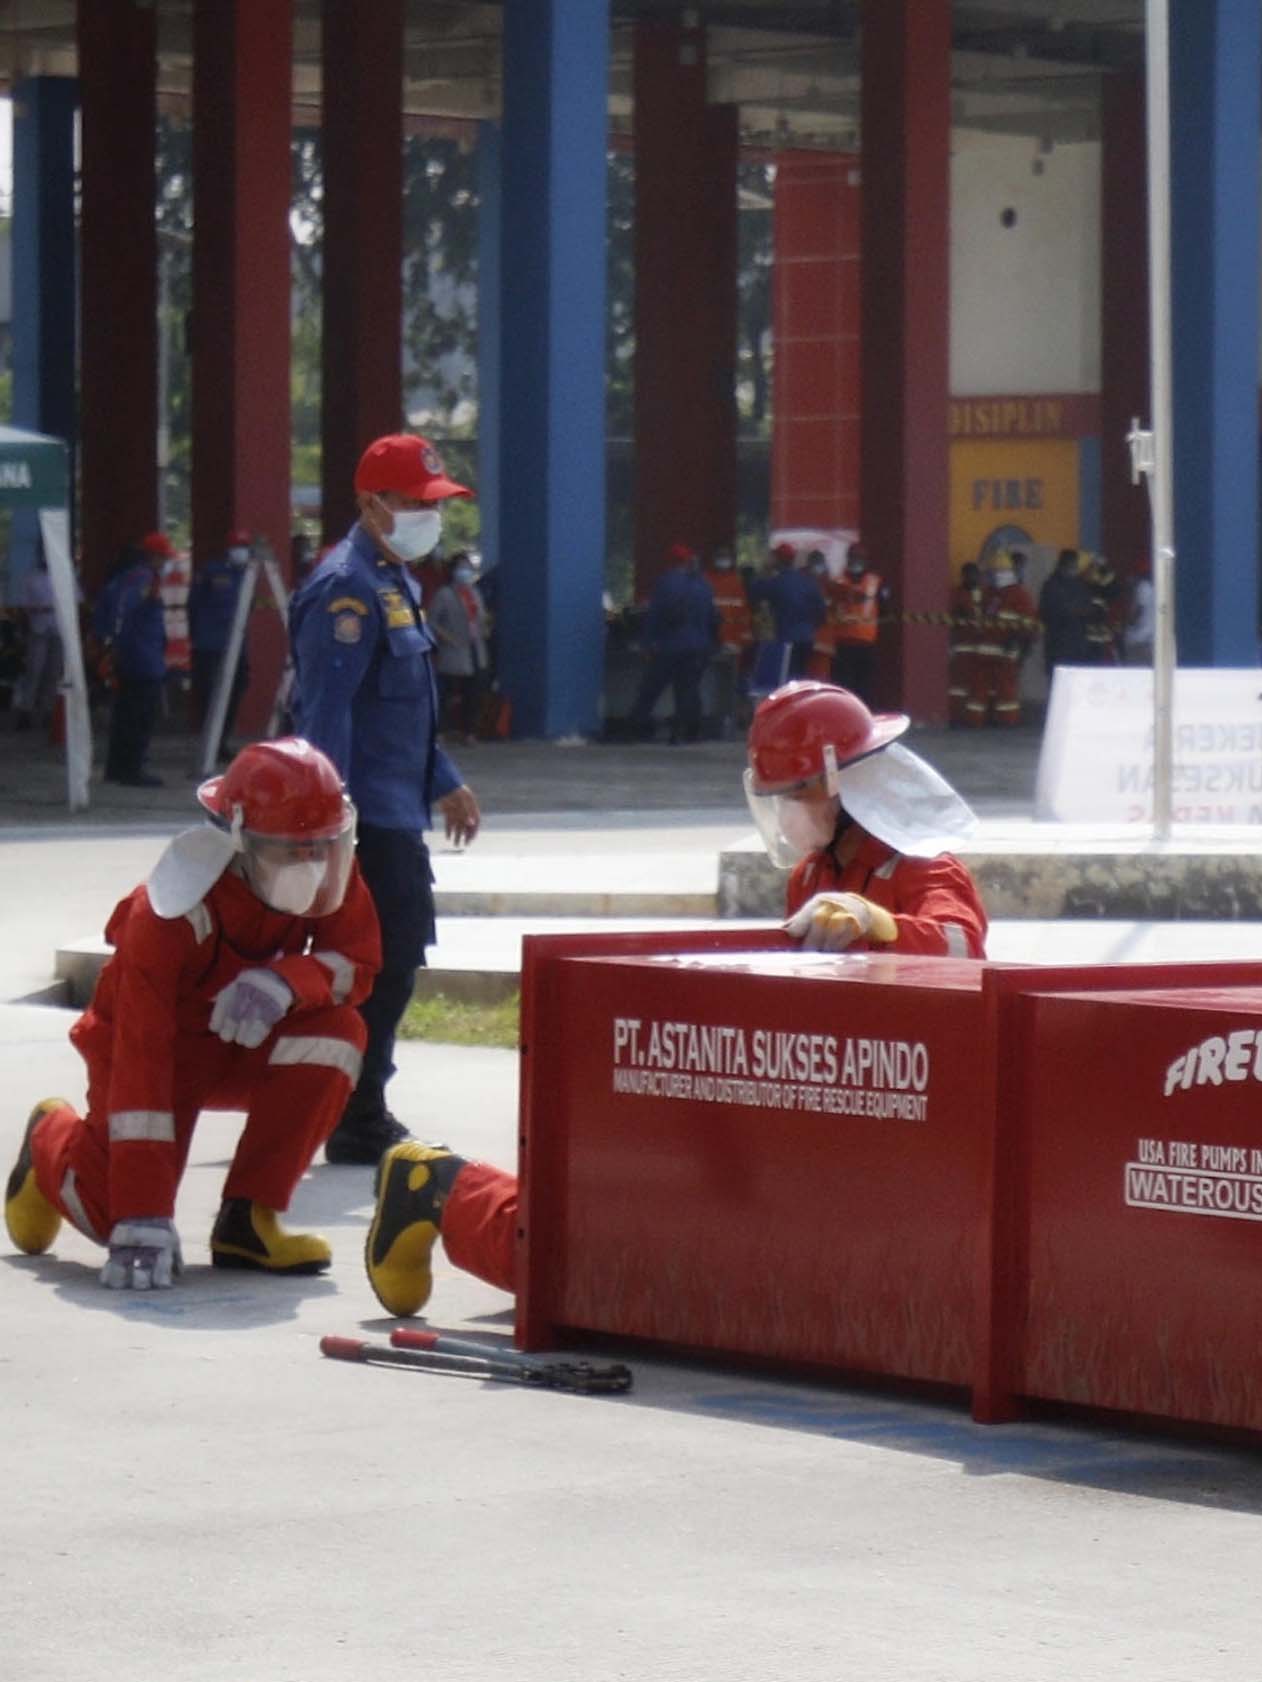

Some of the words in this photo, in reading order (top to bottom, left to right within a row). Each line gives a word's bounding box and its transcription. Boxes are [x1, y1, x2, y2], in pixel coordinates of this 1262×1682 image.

[972, 479, 1045, 510] FIRE
[647, 1021, 747, 1076] ASTANITA
[753, 1030, 836, 1083] SUKSES
[842, 1037, 929, 1092] APINDO
[613, 1068, 692, 1098] MANUFACTURER
[693, 1075, 714, 1101] AND
[716, 1077, 781, 1109] DISTRIBUTOR
[783, 1084, 797, 1109] OF
[798, 1085, 822, 1112] FIRE
[823, 1087, 865, 1115] RESCUE
[866, 1090, 928, 1121] EQUIPMENT
[1138, 1139, 1165, 1164] USA
[1168, 1141, 1197, 1168] FIRE
[1201, 1144, 1247, 1173] PUMPS
